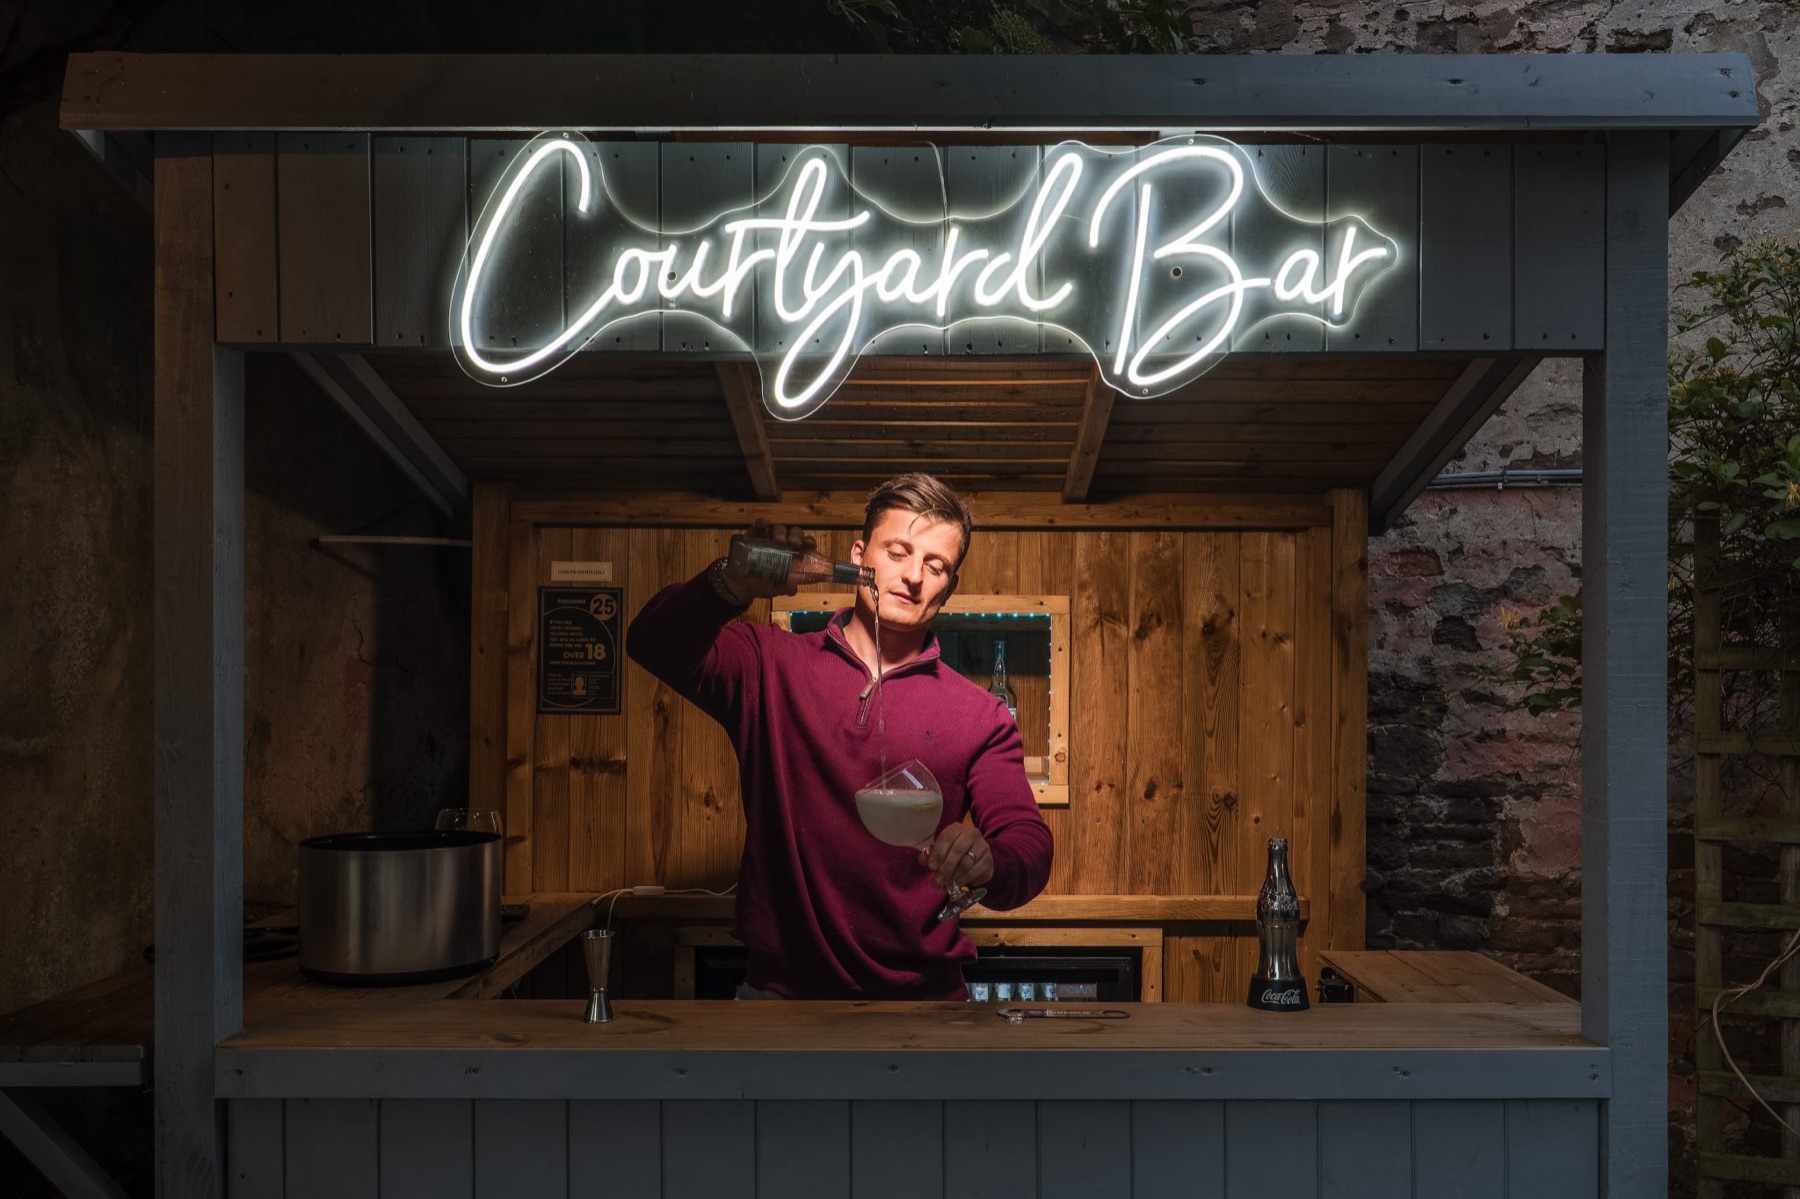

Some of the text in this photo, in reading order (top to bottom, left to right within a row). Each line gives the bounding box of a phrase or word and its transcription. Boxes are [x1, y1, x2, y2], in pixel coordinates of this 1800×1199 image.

[459, 138, 1389, 411] Courtyard Bar
[592, 598, 615, 615] 25
[563, 643, 606, 660] OVER 18
[1261, 988, 1301, 1005] Coca-Cola
